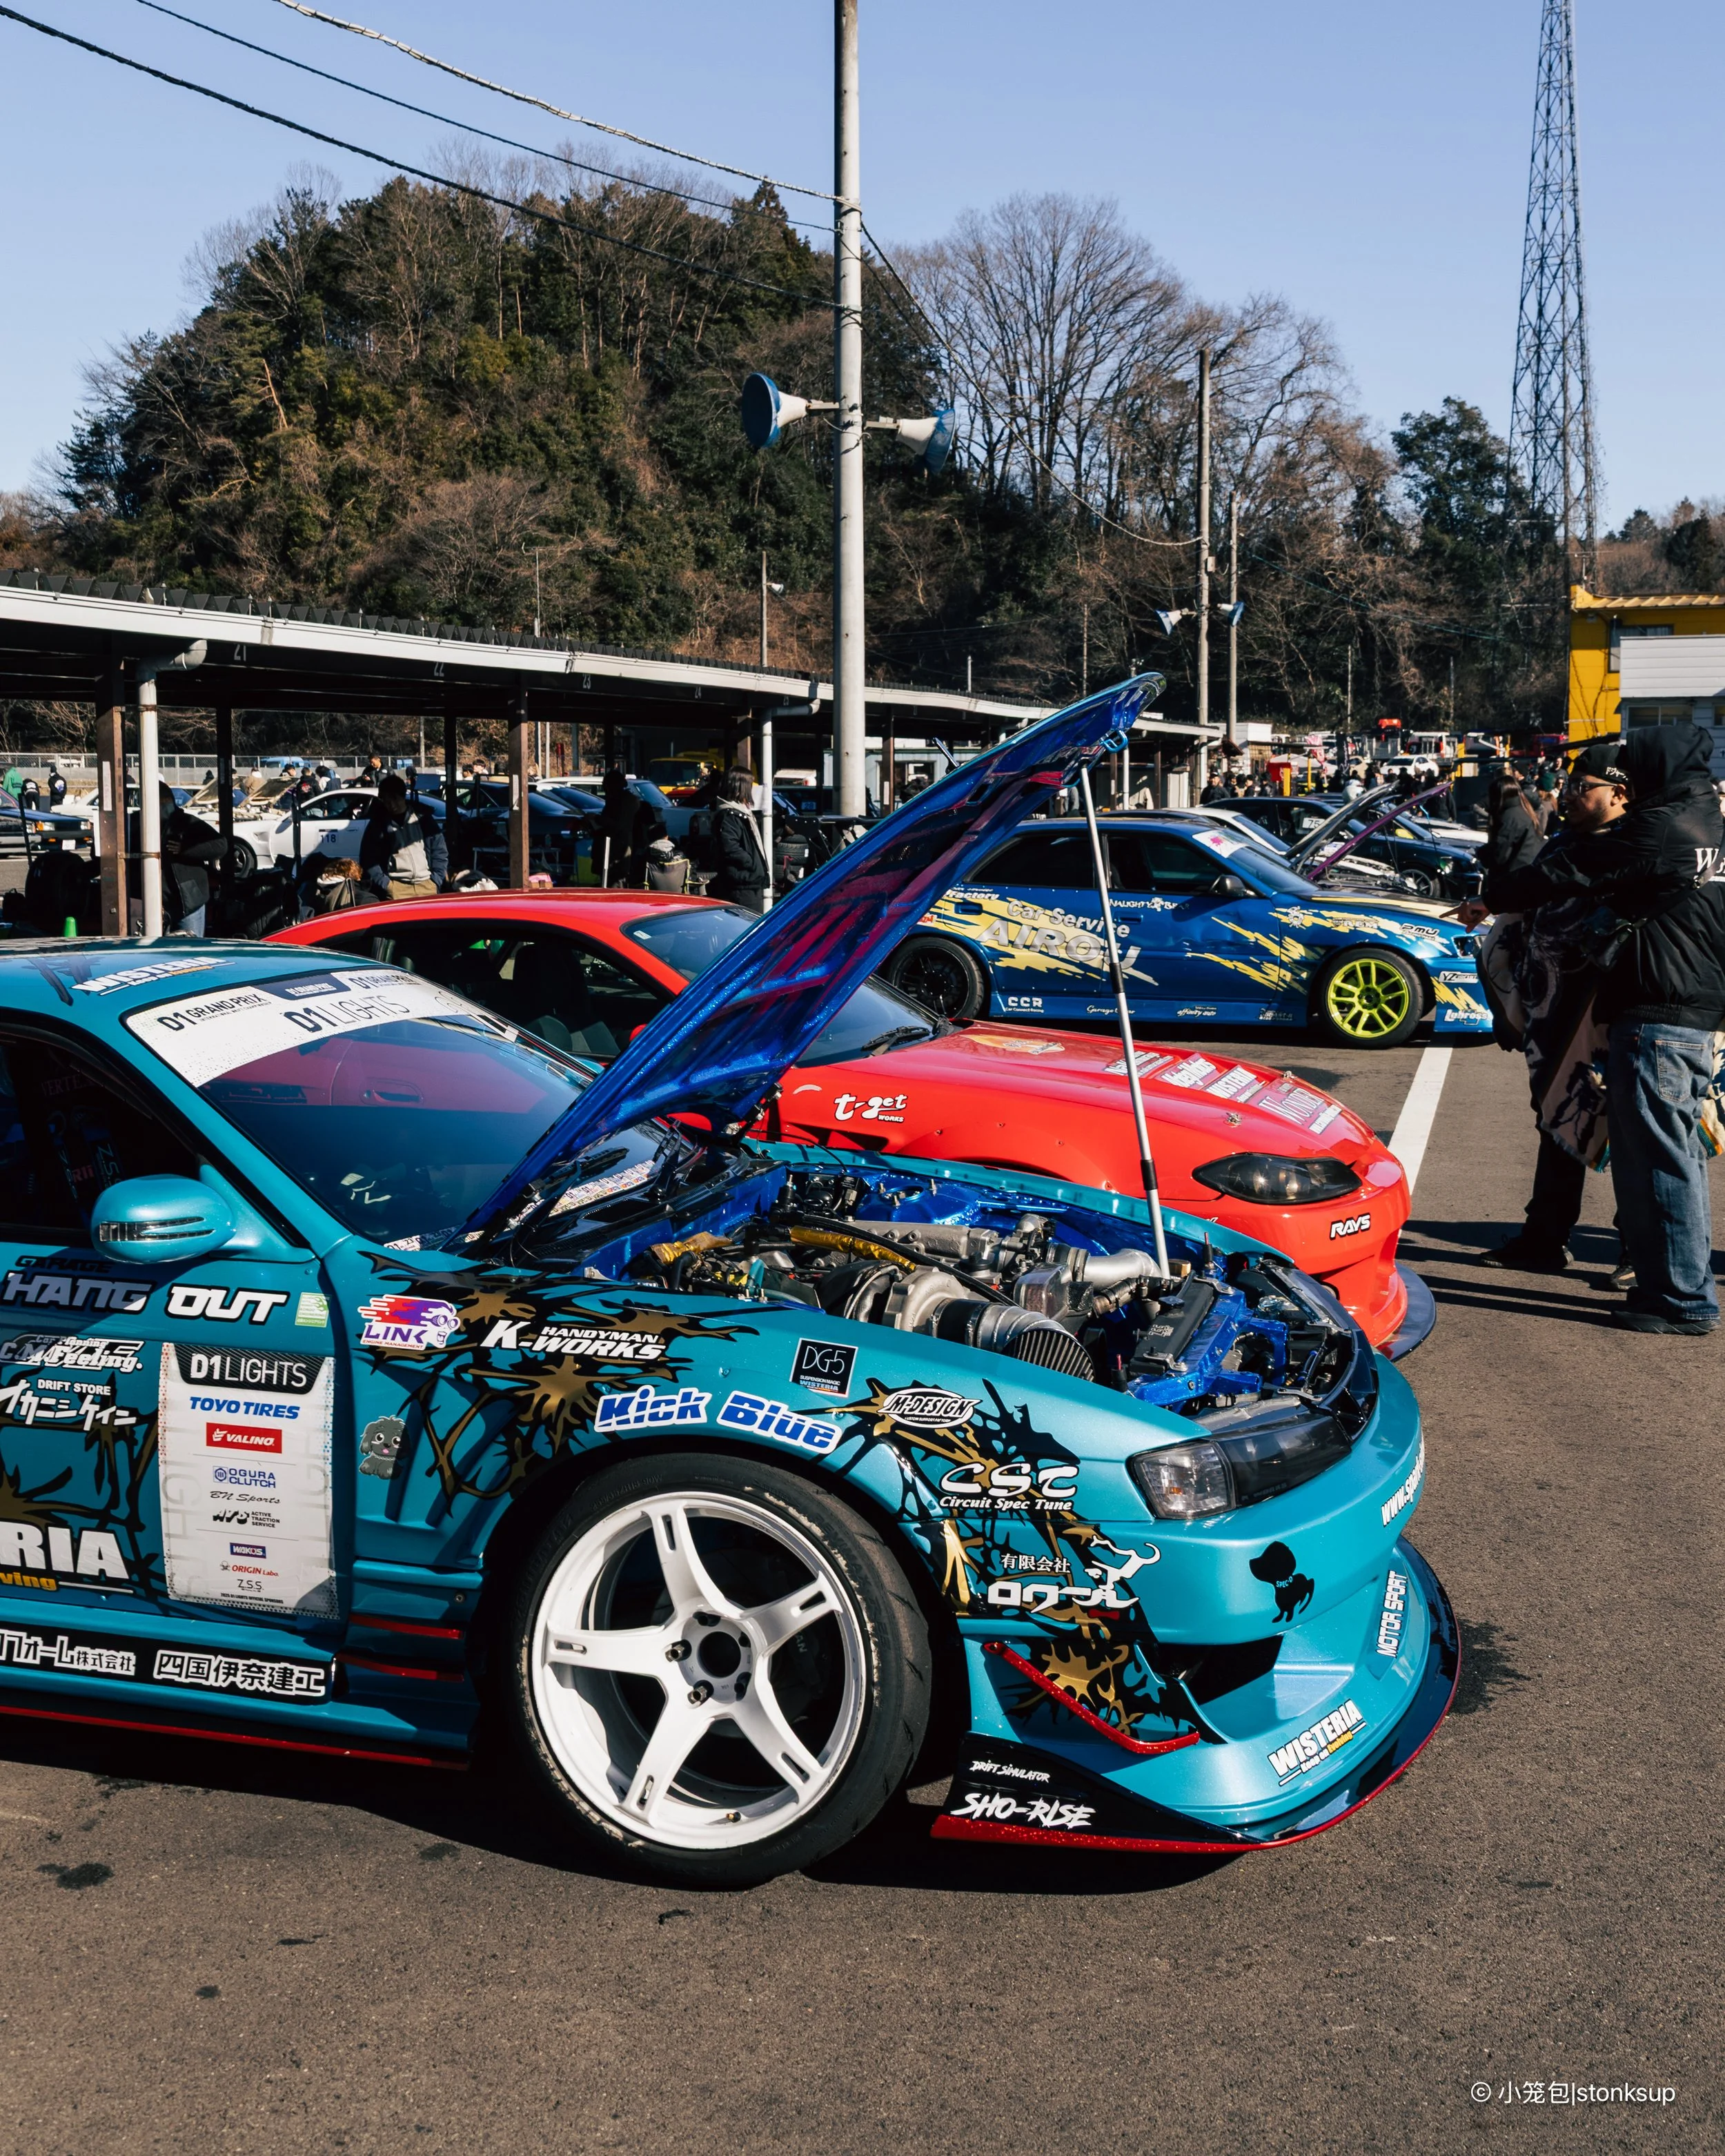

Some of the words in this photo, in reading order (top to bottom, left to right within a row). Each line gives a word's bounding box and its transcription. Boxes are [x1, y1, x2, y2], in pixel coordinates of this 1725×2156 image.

[320, 833, 336, 843] 118
[1007, 900, 1045, 920] Car
[71, 956, 227, 992] WISTERIA
[1007, 996, 1043, 1008] CCR
[1087, 1005, 1114, 1015] Garage
[1176, 1008, 1203, 1018] affinity
[878, 1115, 905, 1123] WORKS
[1330, 1214, 1371, 1238] RAYS
[2, 1272, 153, 1312] HANG
[167, 1285, 287, 1323] OUT
[364, 1324, 428, 1344] LINK
[480, 1320, 666, 1360] K-WORKS
[540, 1326, 659, 1344] HANDYMAN
[37, 1379, 71, 1392] DRIFT
[73, 1383, 111, 1396] STORE
[800, 1380, 839, 1391] WISTERIA
[189, 1396, 240, 1414] TOYO
[244, 1401, 301, 1420] TIRES
[596, 1386, 709, 1430] Kick
[718, 1392, 838, 1451] Blue
[226, 1433, 275, 1446] VALINO
[229, 1468, 276, 1480] OGURA
[229, 1476, 276, 1488] CLUTCH
[210, 1491, 234, 1500] BN
[236, 1494, 281, 1504] Sports
[940, 1496, 992, 1510] Circuit
[995, 1497, 1029, 1511] Spec
[1035, 1499, 1072, 1511] Tune
[233, 1545, 264, 1556] WAKOS
[232, 1565, 262, 1575] ORIGIN
[1000, 1554, 1071, 1573] 有限会社
[1384, 1570, 1407, 1611] SPORT
[1377, 1611, 1402, 1658] MOTOR
[0, 1629, 137, 1675] フォーム株式会社
[153, 1649, 326, 1697] 四国伊奈建工
[1268, 1699, 1363, 1777] WISTERIA
[950, 1792, 1096, 1830] SHO-RISE
